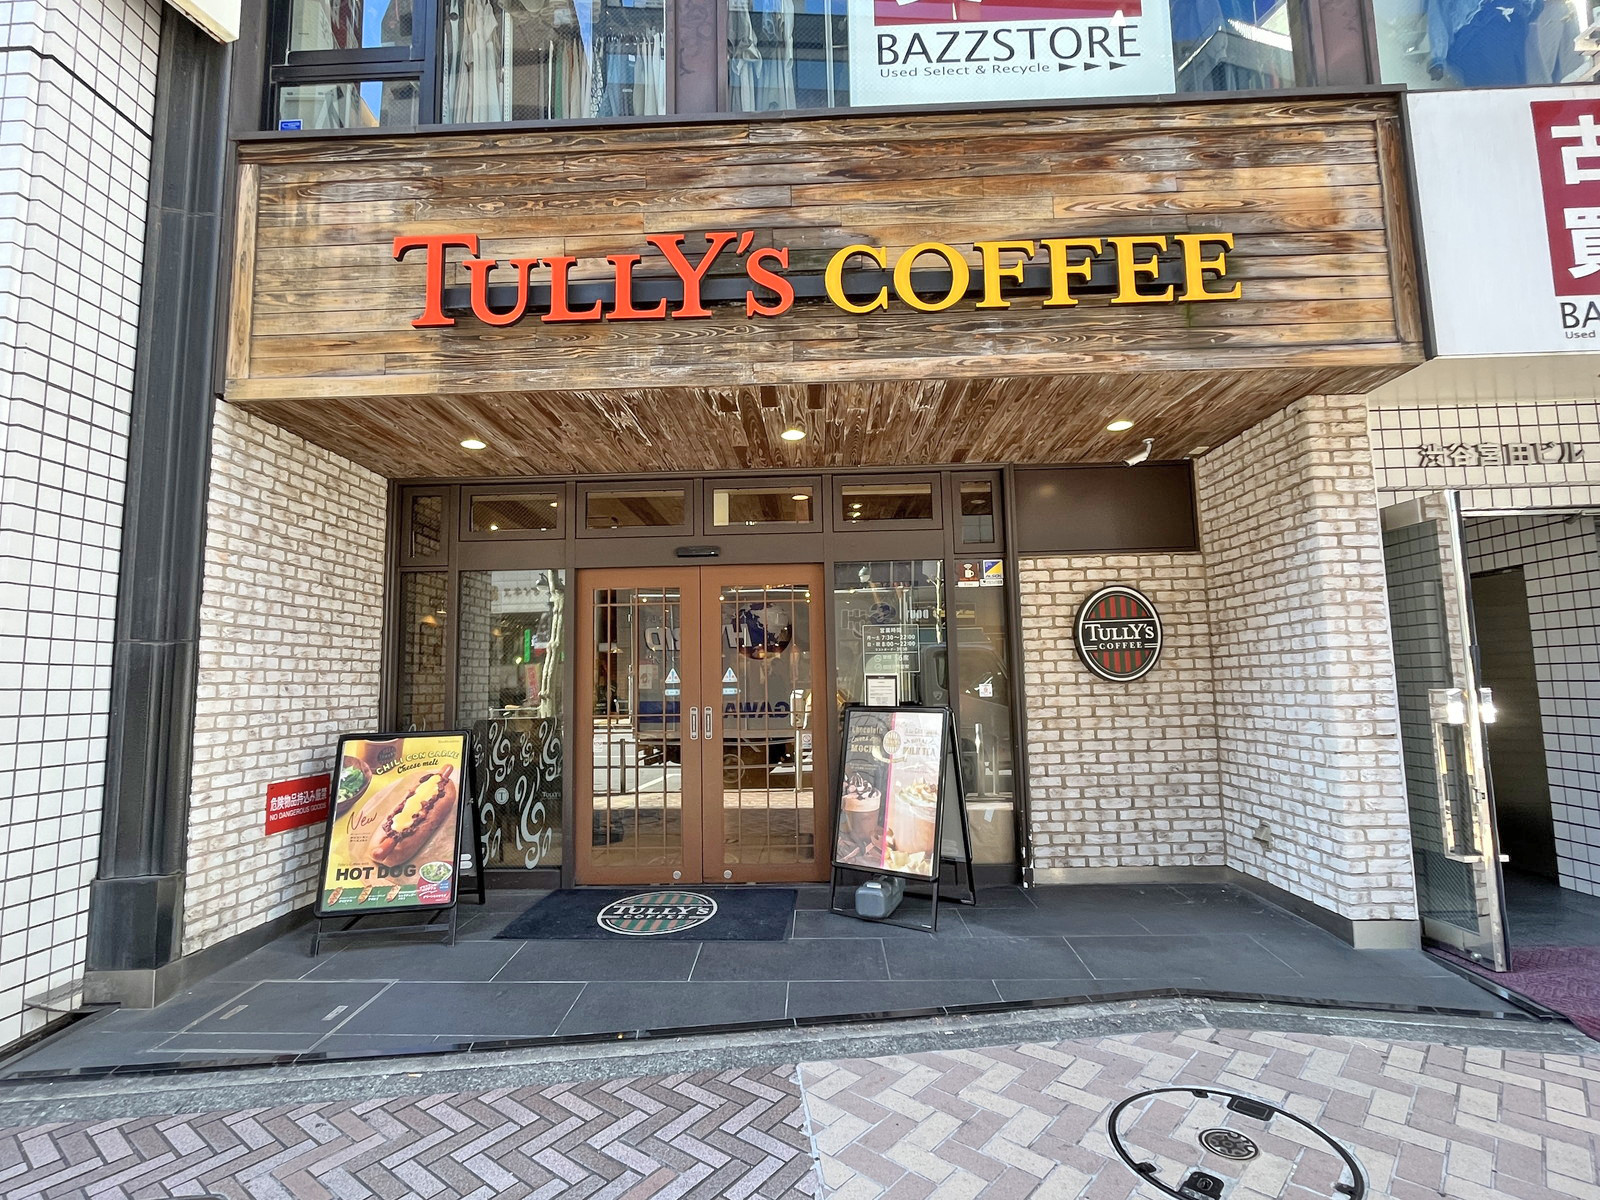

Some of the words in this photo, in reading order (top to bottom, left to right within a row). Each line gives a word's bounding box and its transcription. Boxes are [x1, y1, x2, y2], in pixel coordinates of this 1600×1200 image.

[877, 24, 1141, 65] BAZZSTORE
[880, 67, 918, 78] Used
[923, 66, 970, 76] Select
[975, 64, 987, 75] &
[992, 62, 1050, 75] Recycle
[393, 230, 795, 328] TULLY'S
[824, 232, 1243, 315] COFFEE
[1565, 330, 1596, 339] Used
[1084, 623, 1155, 642] TULLY'S
[1099, 641, 1143, 650] COFFEE
[376, 757, 404, 775] CHILI
[405, 752, 426, 762] CON
[428, 750, 460, 760] CARNE
[397, 761, 422, 774] Cheese
[422, 758, 440, 767] melt
[269, 813, 279, 821] NO
[278, 806, 310, 819] DANGEROUS
[310, 802, 327, 811] GOODS
[346, 811, 378, 834] New
[335, 866, 375, 881] HOT
[377, 864, 417, 879] DOG
